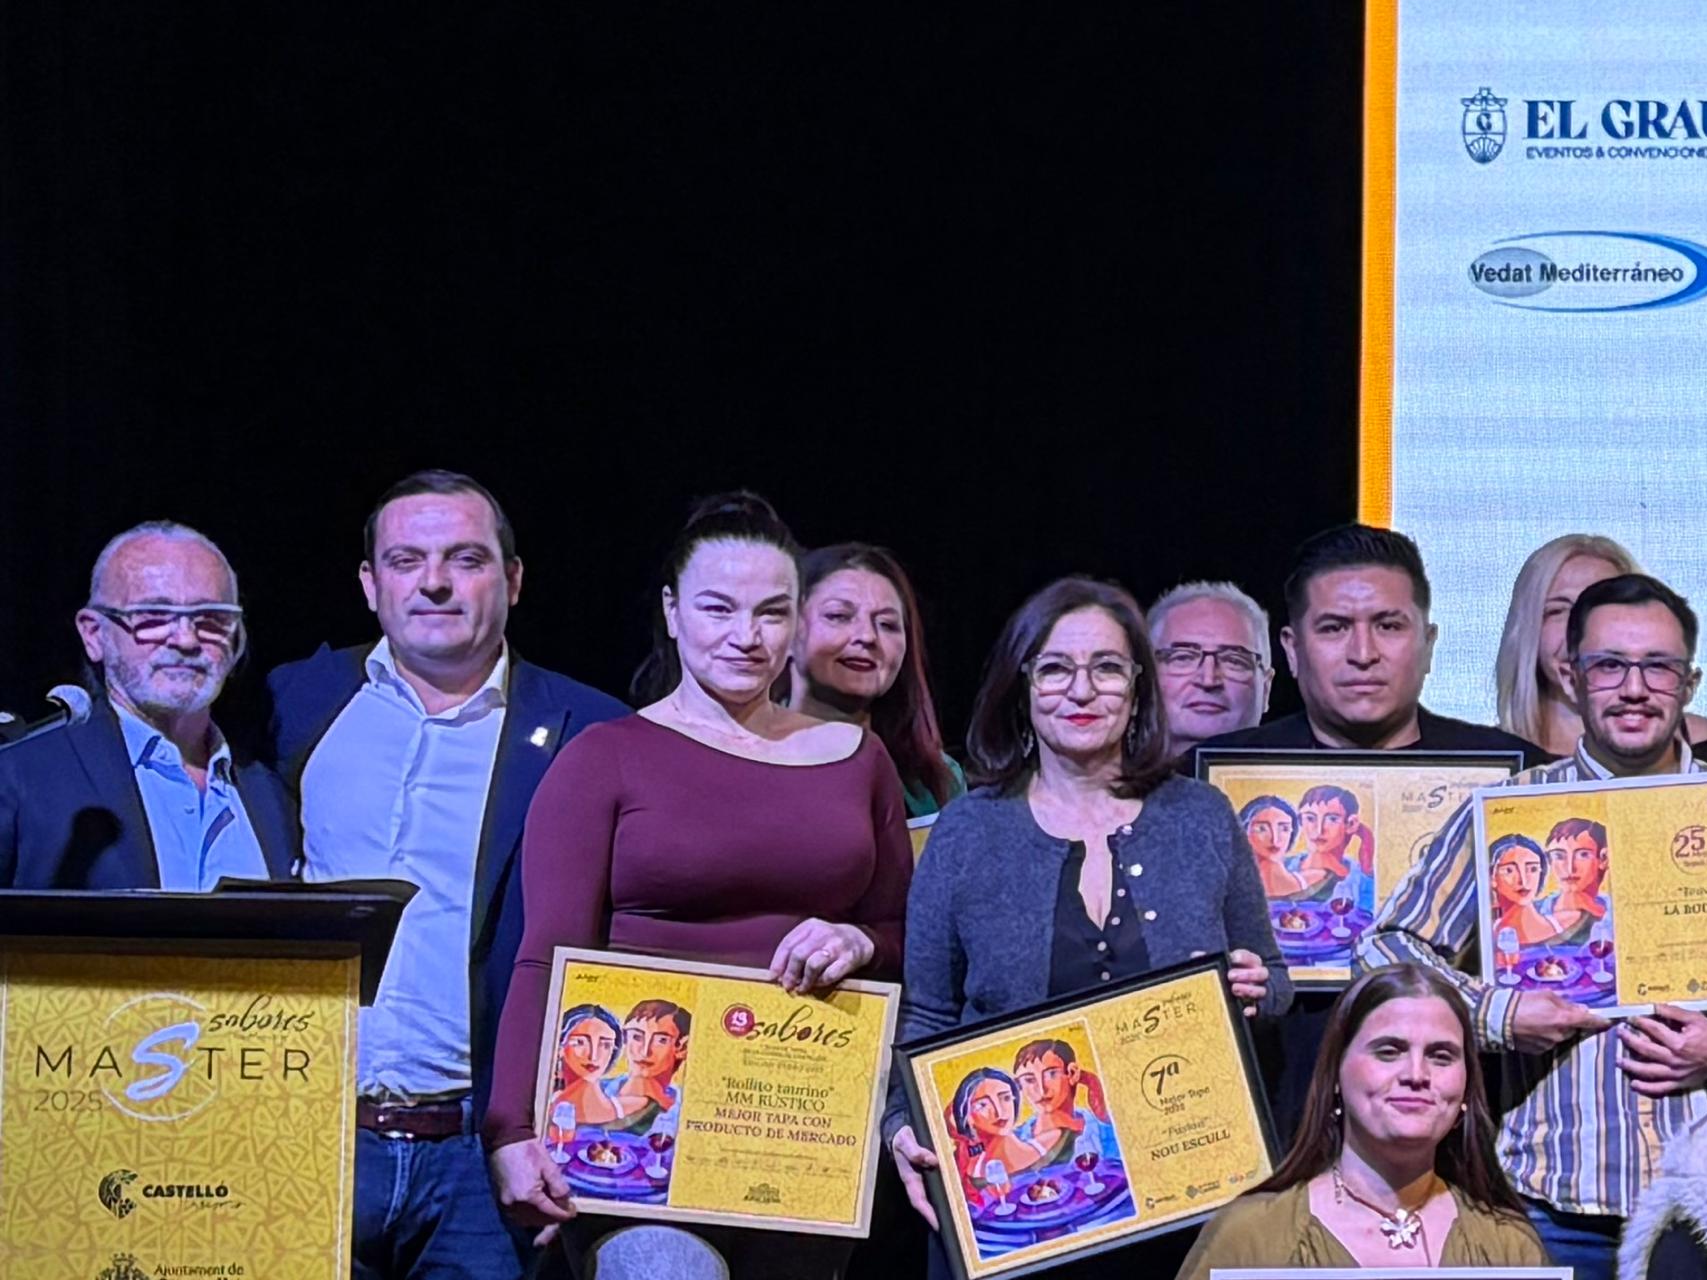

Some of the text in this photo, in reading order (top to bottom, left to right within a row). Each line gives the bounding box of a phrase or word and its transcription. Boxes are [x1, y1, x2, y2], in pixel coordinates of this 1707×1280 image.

[1522, 99, 1588, 140] EL
[1526, 146, 1593, 159] EVENTOS
[1470, 261, 1683, 282] Vedat Mediterráneo
[1674, 828, 1705, 858] 25
[1664, 905, 1680, 916] LA
[35, 1021, 311, 1102] MASTER
[33, 1090, 102, 1112] 2025
[715, 1107, 832, 1129] MEJOR TAPA CON
[685, 1120, 857, 1147] PRODUCTO DE MERCADO
[1151, 1130, 1232, 1161] NOU ESCULL
[143, 1181, 228, 1198] CASTELLÓ
[154, 1263, 244, 1277] Ajuntament de
